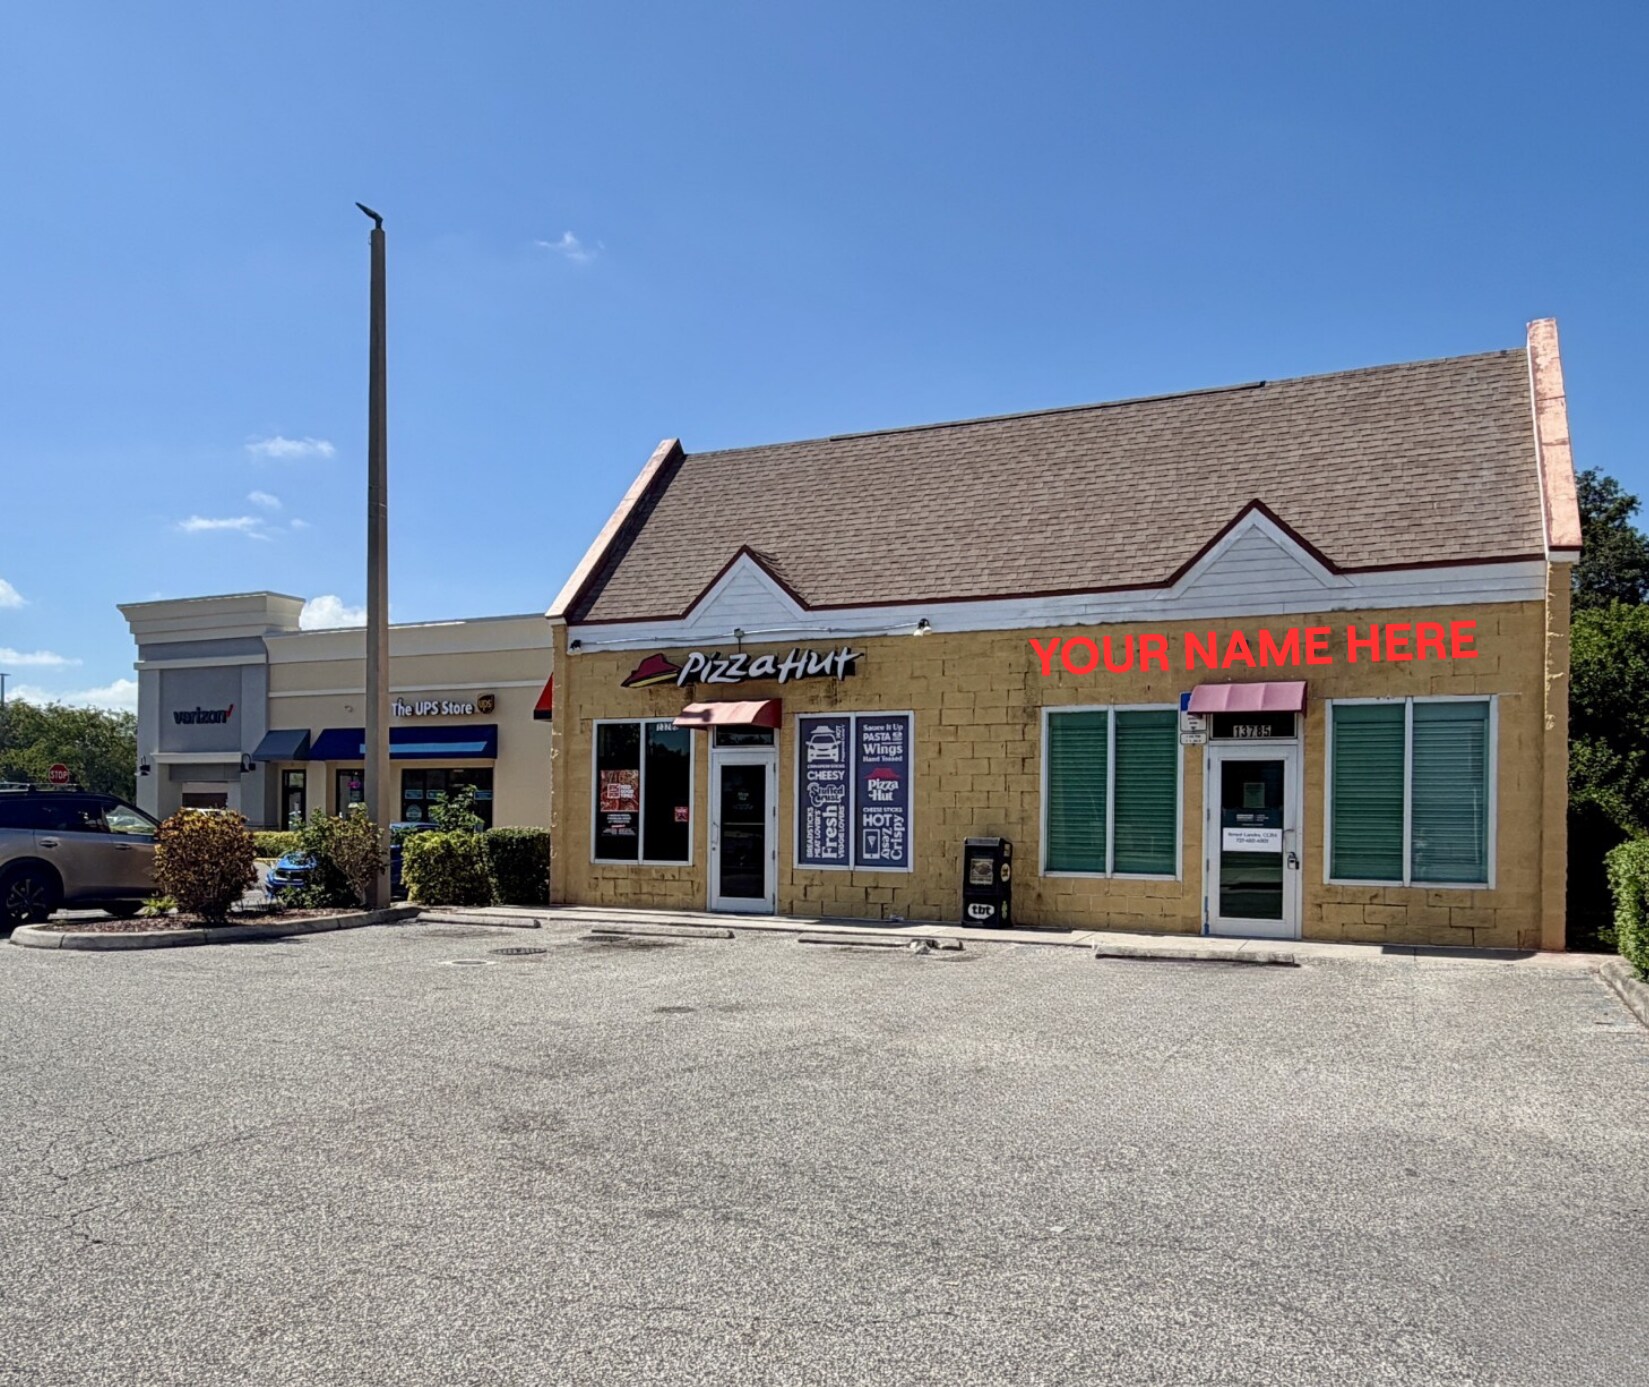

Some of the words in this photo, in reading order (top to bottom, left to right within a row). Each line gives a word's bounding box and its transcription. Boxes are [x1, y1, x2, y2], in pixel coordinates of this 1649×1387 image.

[677, 651, 776, 687] Pizza
[776, 646, 864, 684] Hut
[392, 702, 412, 716] The
[415, 701, 438, 716] UPS
[442, 700, 473, 715] Store
[173, 706, 227, 724] verizon
[863, 732, 891, 741] PASTA
[1233, 725, 1272, 738] 13785
[863, 743, 904, 756] Wings
[50, 770, 68, 780] STOP
[807, 770, 846, 780] CHEESY
[868, 778, 899, 790] Pizza
[868, 790, 893, 801] Hut
[863, 814, 893, 826] HOT
[822, 805, 837, 858] Fresh
[890, 815, 905, 860] Crispy
[881, 827, 893, 859] Zesty
[972, 905, 991, 915] tbt
